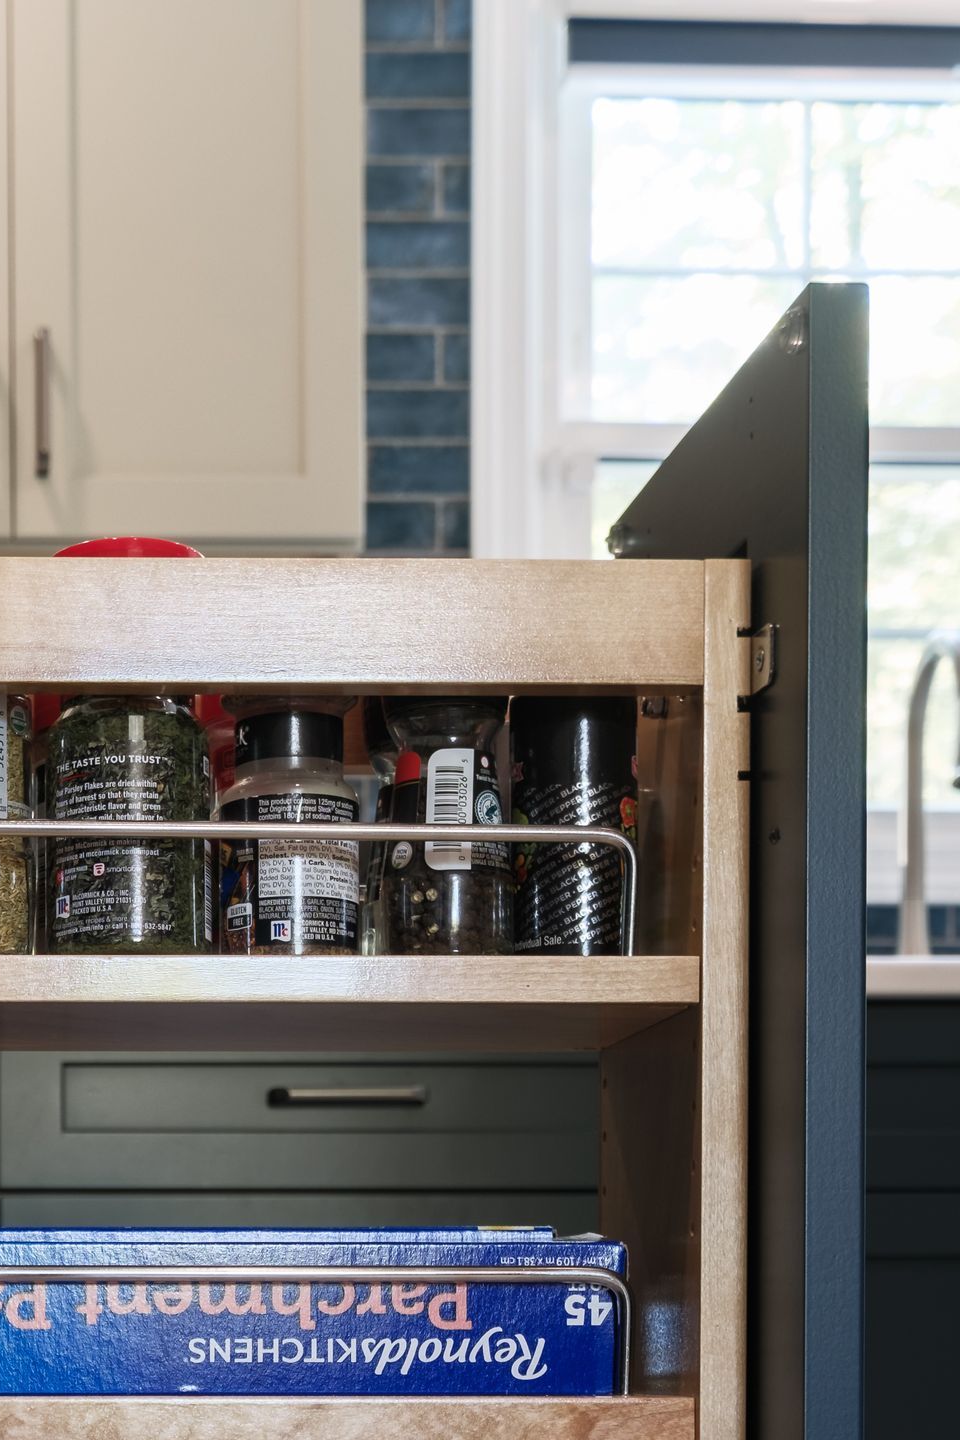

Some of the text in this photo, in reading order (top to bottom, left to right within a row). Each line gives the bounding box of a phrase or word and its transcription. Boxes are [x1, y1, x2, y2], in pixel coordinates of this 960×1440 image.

[56, 755, 161, 774] THE TASTE YOU TRUST
[84, 781, 104, 791] Flakes
[117, 779, 136, 787] dried
[107, 790, 122, 799] that
[77, 1281, 473, 1331] Parchment
[564, 1294, 613, 1326] 45
